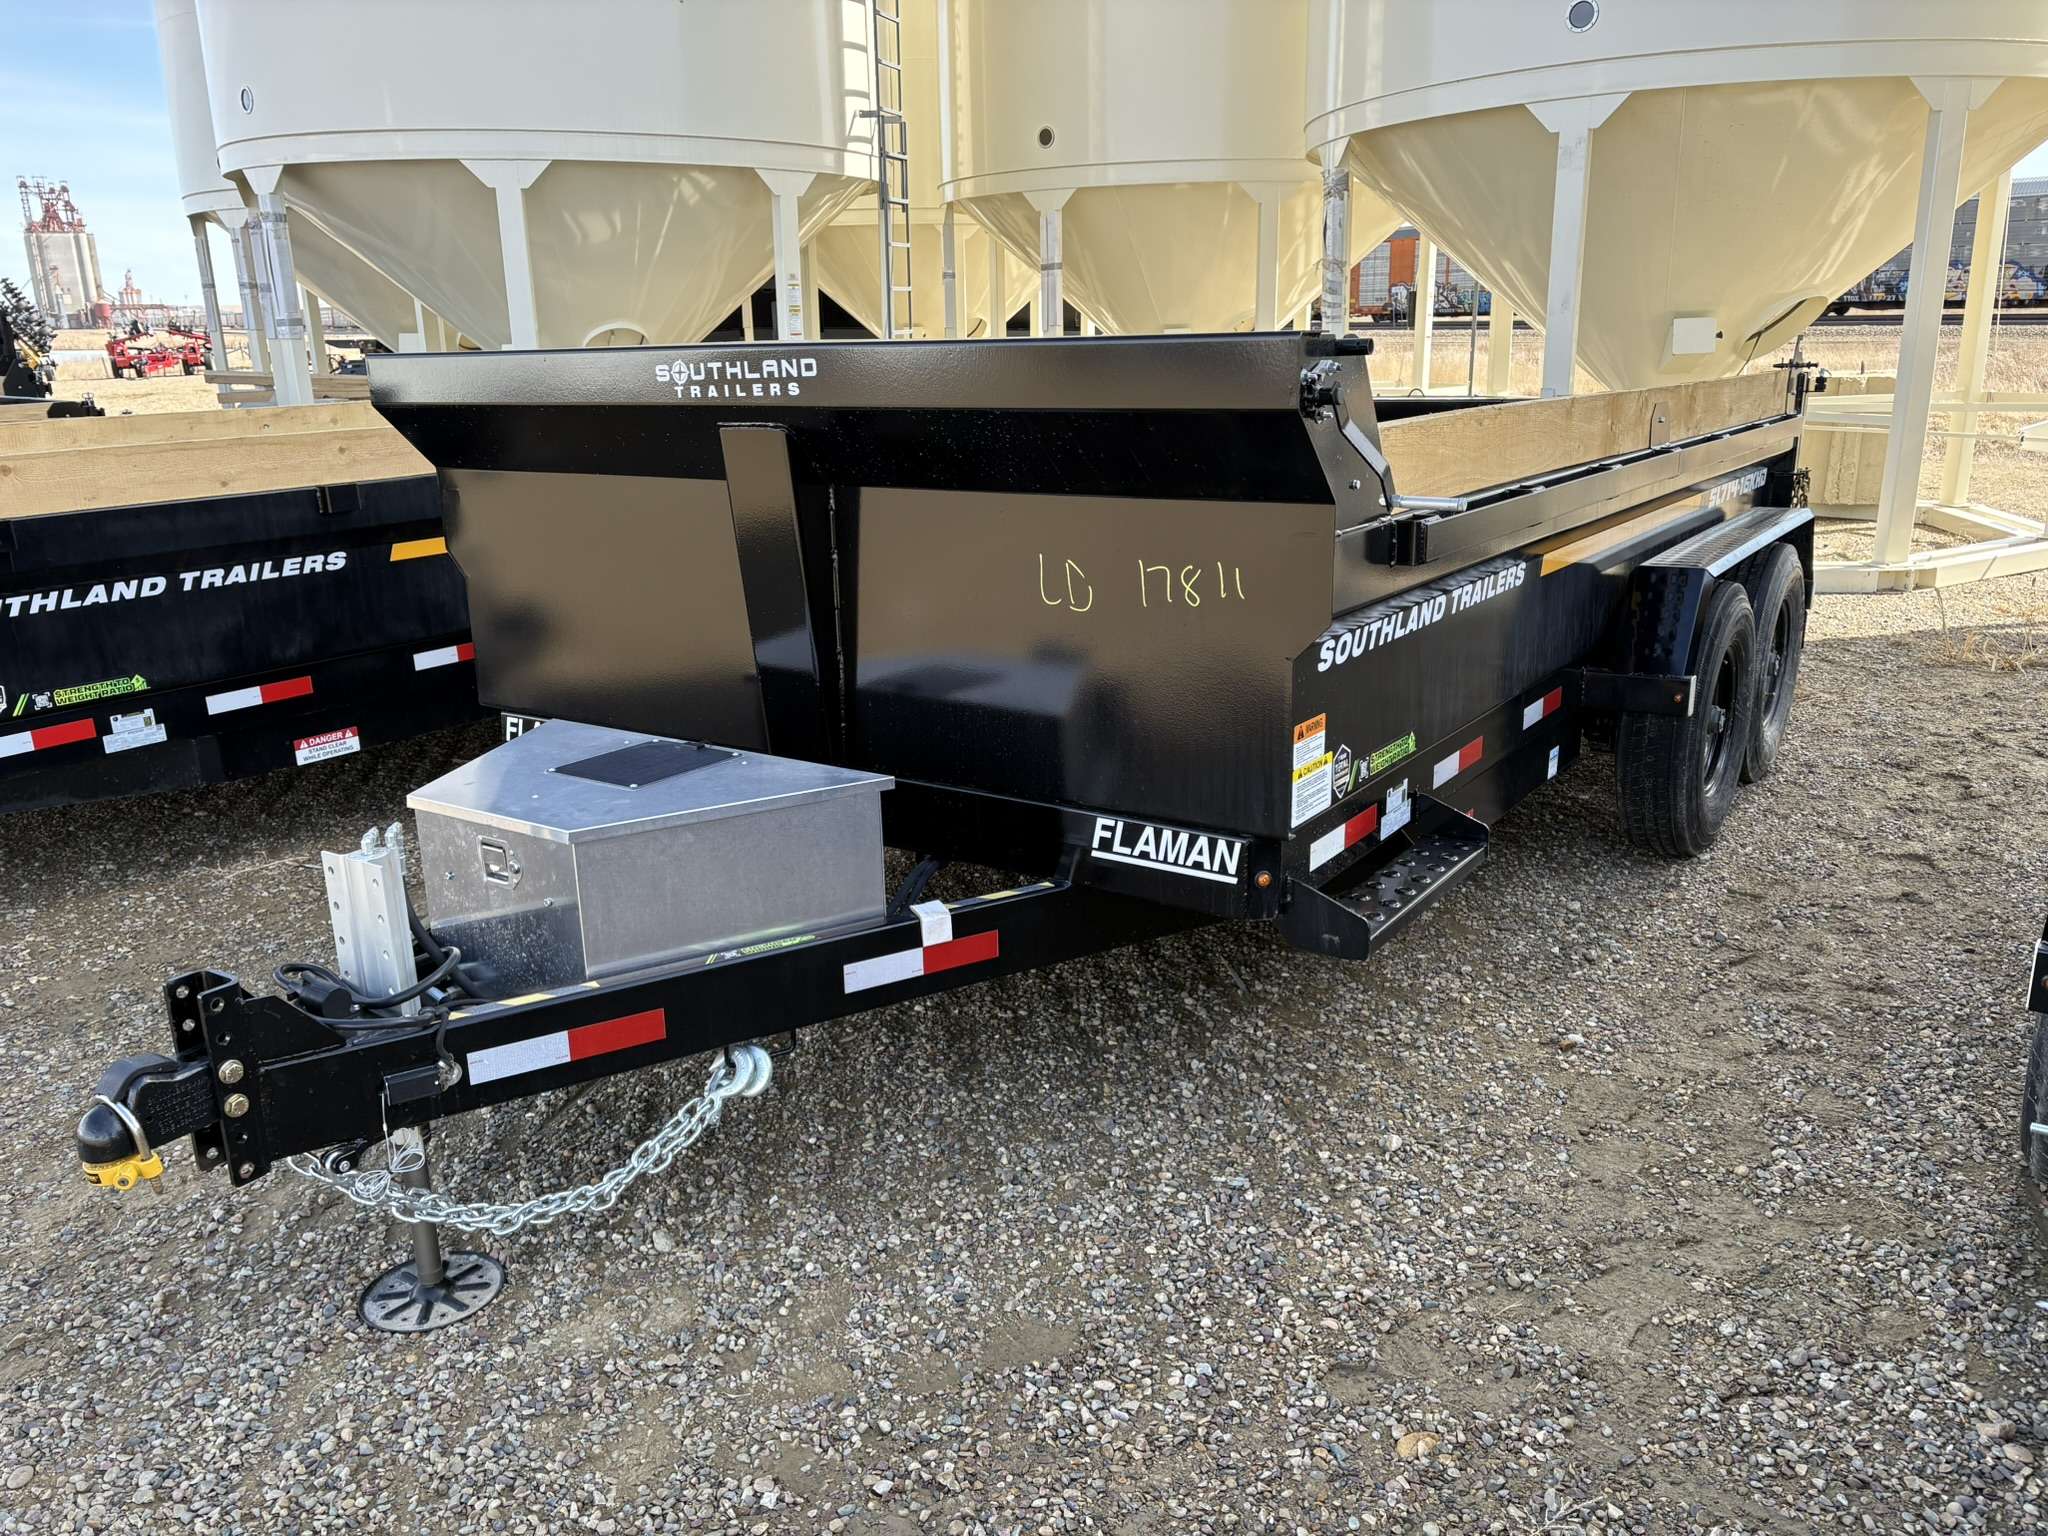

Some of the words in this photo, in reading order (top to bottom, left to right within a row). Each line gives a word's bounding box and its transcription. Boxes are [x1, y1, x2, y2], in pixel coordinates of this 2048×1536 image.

[655, 358, 818, 385] SOUTHLAND
[674, 382, 800, 398] TRAILERS
[0, 576, 167, 618] THLAND
[179, 551, 347, 592] TRAILERS
[1138, 559, 1245, 608] 17811
[1317, 593, 1447, 673] SOUTHLAND
[1451, 561, 1527, 615] TRAILERS
[55, 679, 113, 698] STRENGTH
[114, 678, 130, 686] TO
[56, 692, 100, 705] WEIGHT
[101, 685, 134, 697] RATIO
[309, 731, 343, 746] DANGER
[505, 716, 541, 742] FL
[303, 753, 322, 762] WHILE
[322, 746, 354, 757] OPERATING
[308, 745, 328, 754] STAND
[328, 740, 347, 750] CLEAR
[1302, 761, 1323, 776] CAUTION
[1092, 817, 1242, 875] FLAMAN
